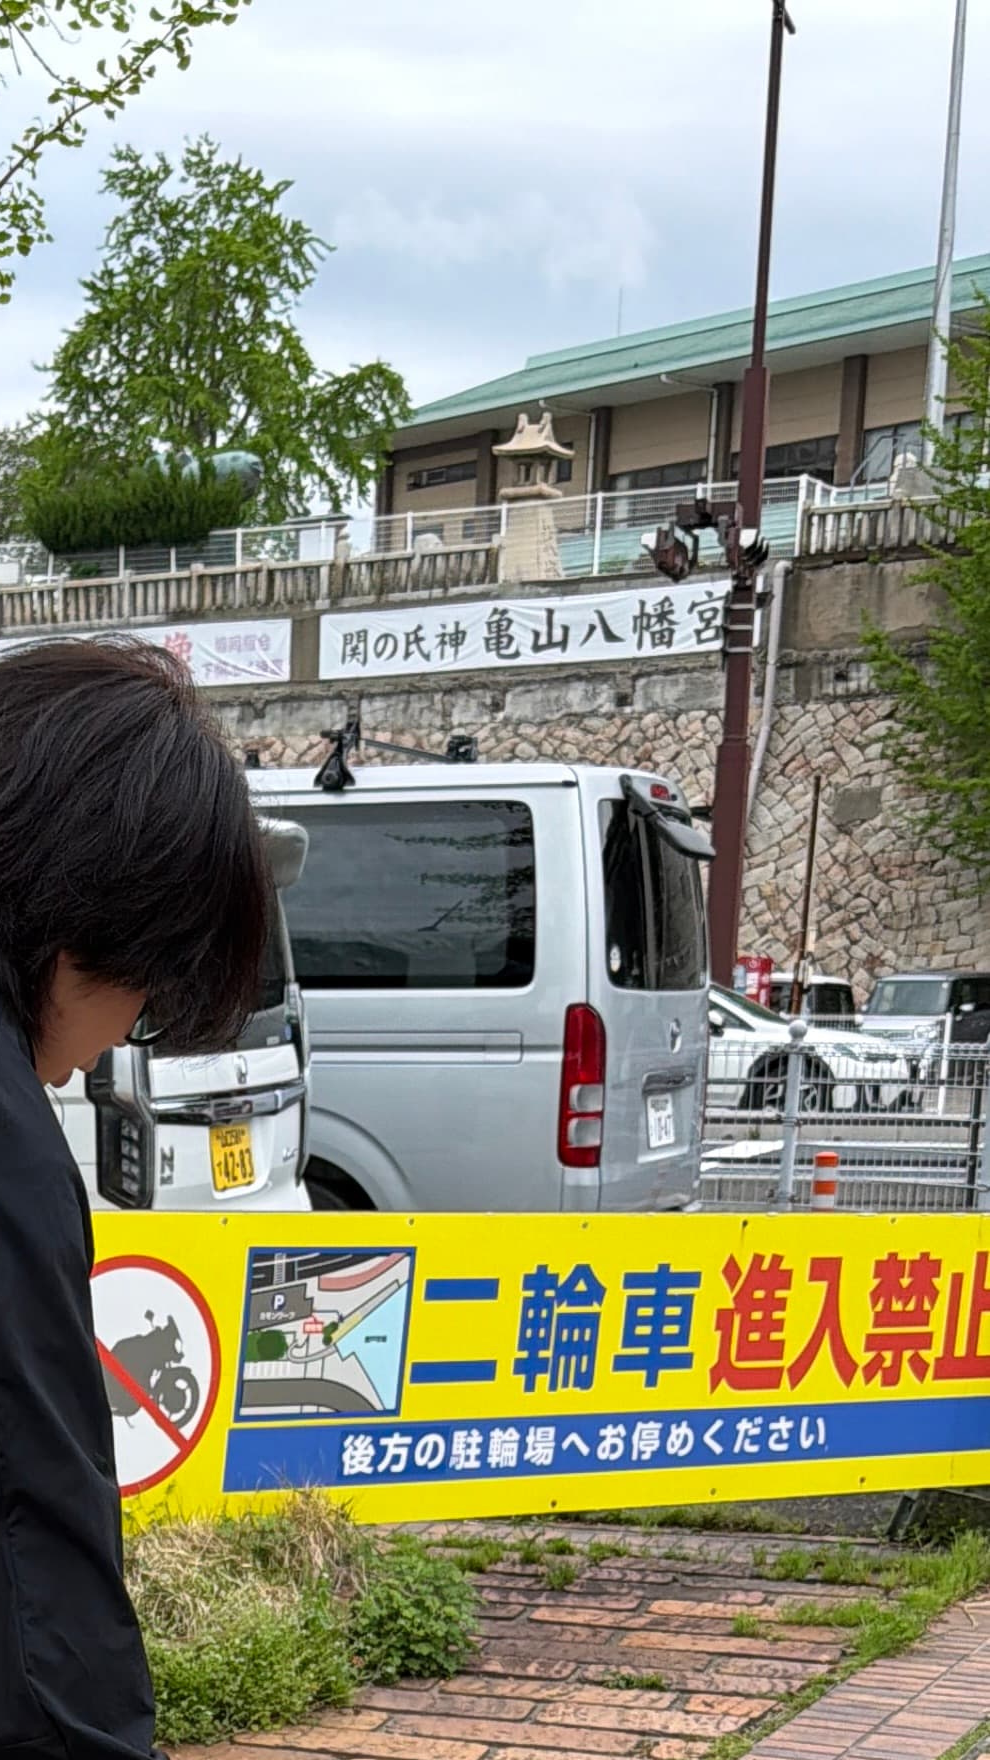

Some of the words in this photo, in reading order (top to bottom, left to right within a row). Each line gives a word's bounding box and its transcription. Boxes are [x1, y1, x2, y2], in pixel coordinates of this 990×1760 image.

[342, 1416, 827, 1476] 後方の駐輪場へお停めください
